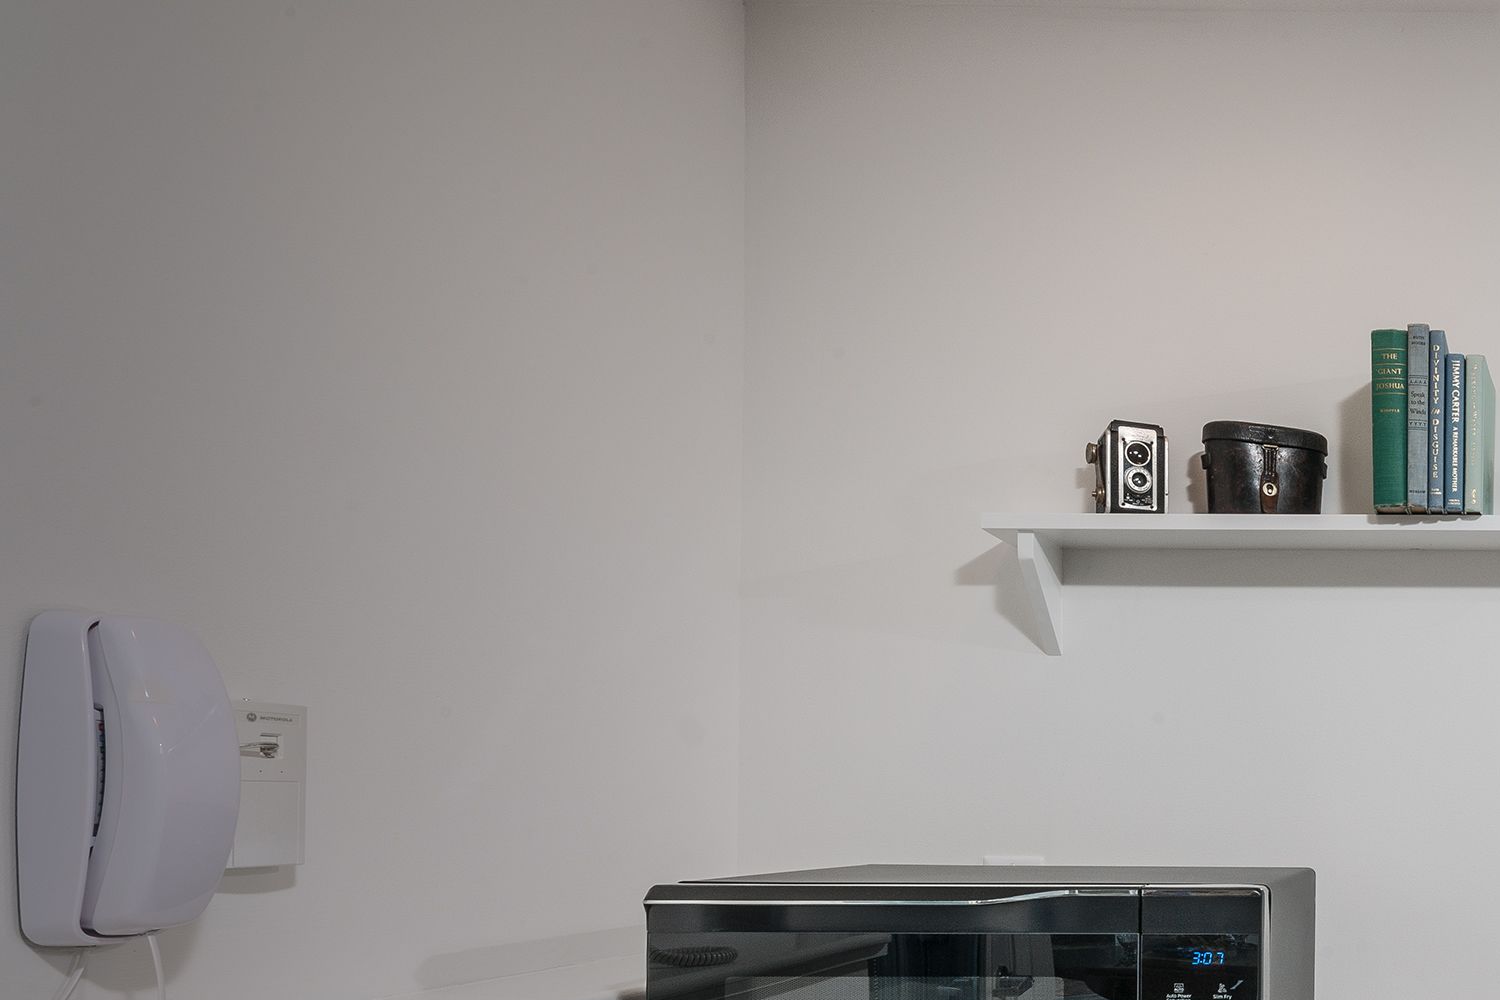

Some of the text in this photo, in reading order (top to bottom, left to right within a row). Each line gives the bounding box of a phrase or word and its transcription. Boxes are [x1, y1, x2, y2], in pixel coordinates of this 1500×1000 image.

[1382, 352, 1398, 360] THE
[1377, 367, 1403, 375] GIANT
[1432, 344, 1440, 405] DIVINITY
[1451, 360, 1461, 389] JIMMY
[1376, 382, 1405, 390] JOSHUA
[1410, 390, 1425, 399] Speak
[1451, 389, 1460, 424] CARTER
[1431, 418, 1440, 479] DISGUISE
[1191, 951, 1225, 966] 3:07
